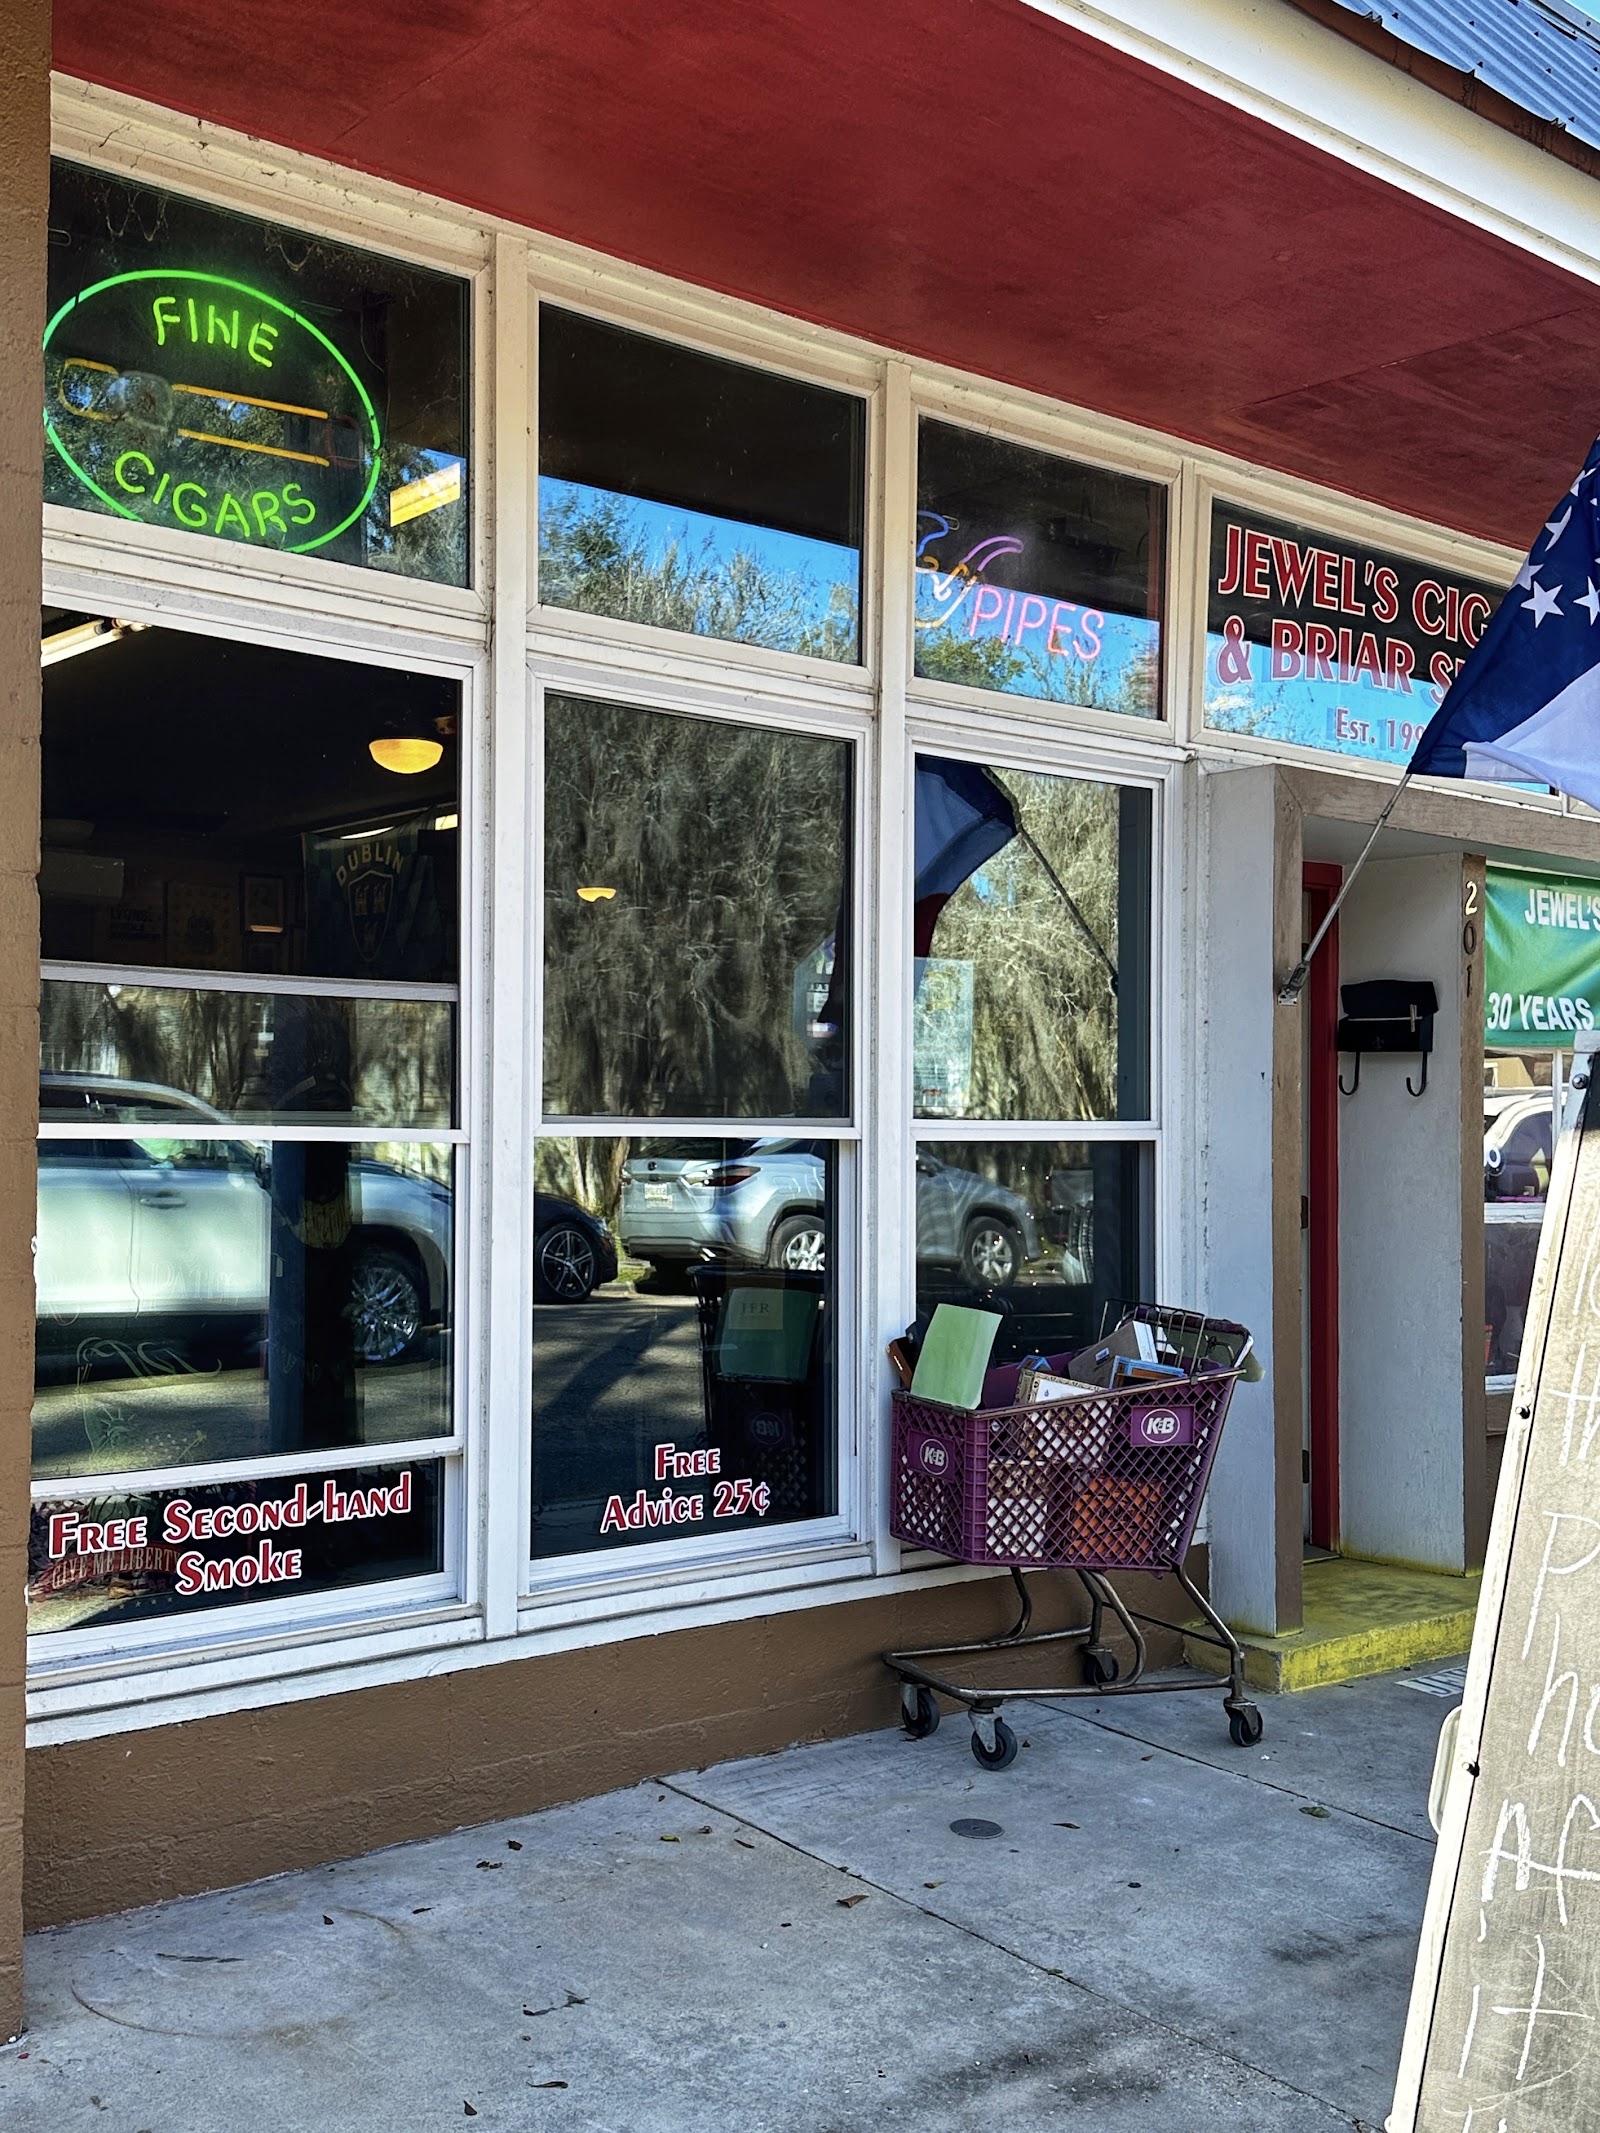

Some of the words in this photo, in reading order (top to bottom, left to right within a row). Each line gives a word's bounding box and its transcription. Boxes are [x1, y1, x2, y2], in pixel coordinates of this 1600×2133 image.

[152, 296, 280, 368] FINE
[115, 450, 317, 538] CIGARS
[1218, 524, 1399, 624] JEWEL'S
[970, 585, 1105, 661] PIPES
[1217, 615, 1253, 686] &
[1271, 619, 1415, 696] BRIAR
[1429, 651, 1466, 706] S
[336, 842, 404, 887] DUBLIN
[1487, 992, 1512, 1030] 30
[1519, 994, 1595, 1031] YEARS
[713, 1477, 771, 1518] 25¢
[51, 1554, 88, 1590] GIVE
[92, 1550, 116, 1576] ME
